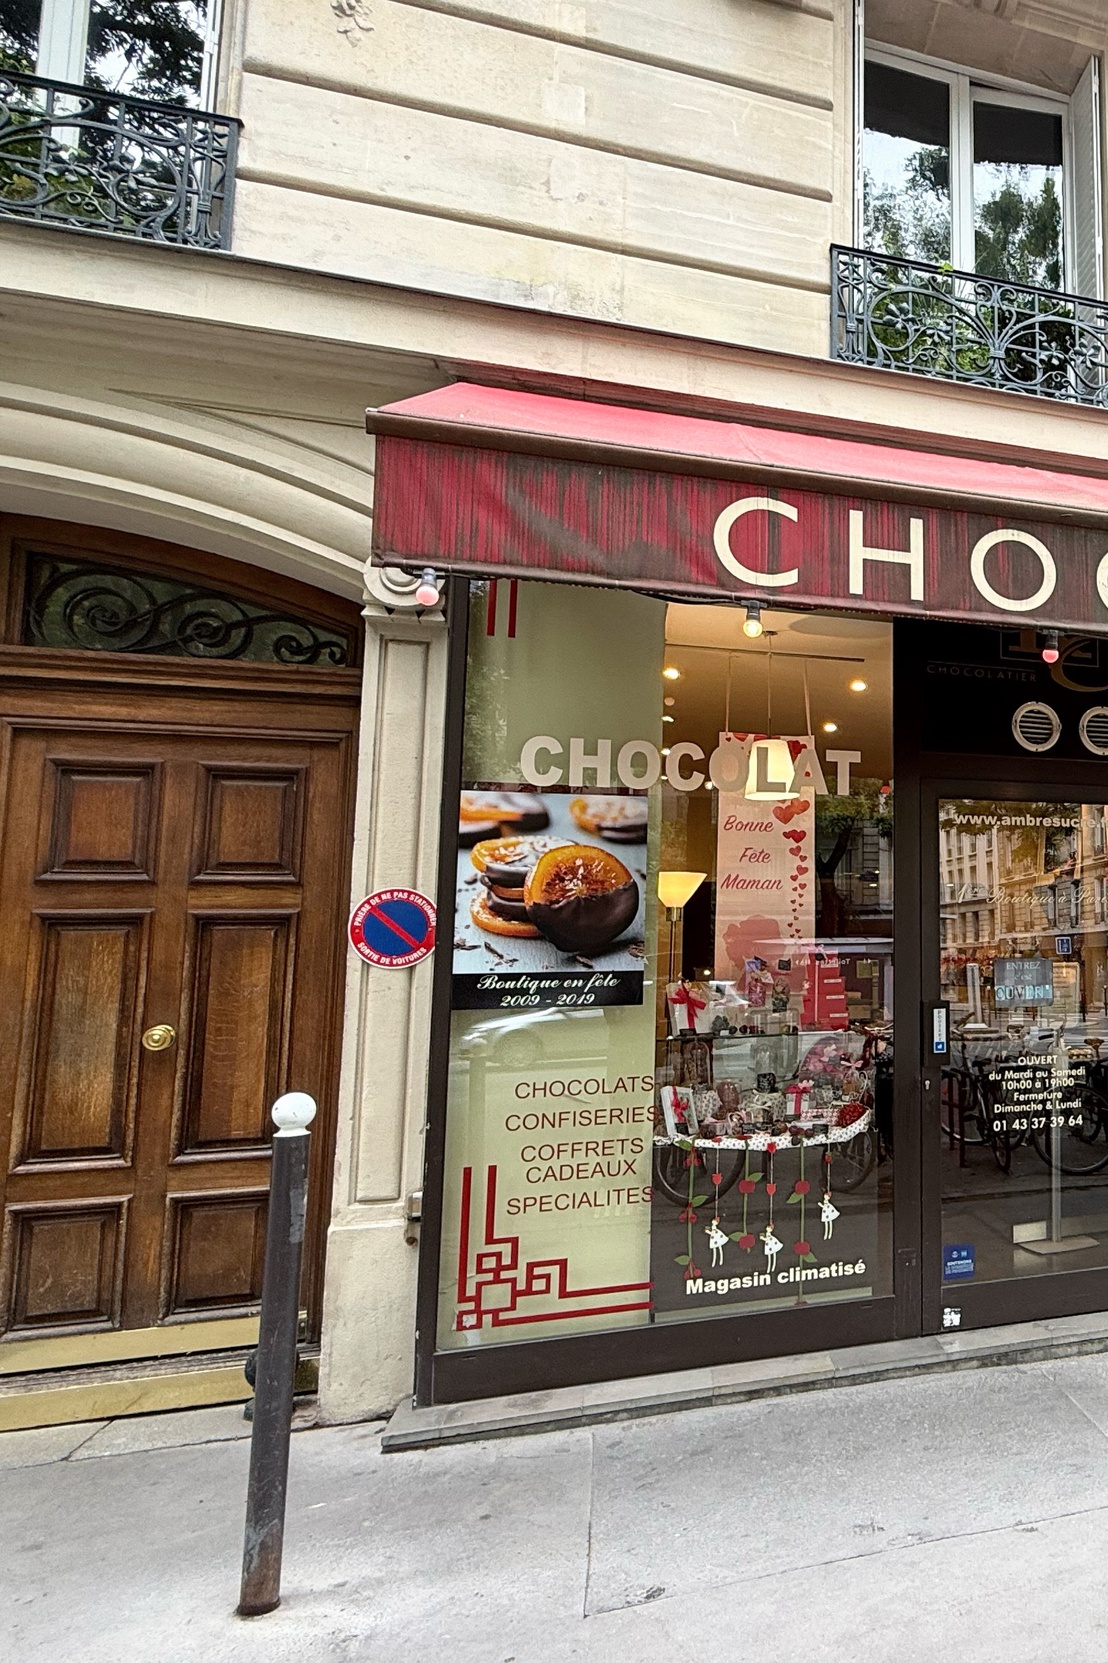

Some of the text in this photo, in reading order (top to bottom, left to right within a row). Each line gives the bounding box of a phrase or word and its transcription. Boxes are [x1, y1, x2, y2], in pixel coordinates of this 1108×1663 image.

[926, 663, 1038, 683] CHOCOLATIER
[520, 735, 862, 796] CHOCOLAT
[723, 815, 775, 832] Bonne
[720, 873, 784, 890] Maman
[370, 897, 382, 906] DE
[381, 891, 392, 900] NE
[393, 891, 408, 899] PAS
[986, 885, 1055, 910] Boutique
[357, 941, 427, 965] SORTIE DE VOITURES
[1006, 961, 1041, 970] ENTREZ
[477, 973, 621, 994] Boutique en fête
[500, 994, 541, 1007] 2009
[556, 993, 596, 1005] 2019
[1017, 1055, 1058, 1066] OUVERT
[988, 1066, 1086, 1081] du Mardi au Samedi
[514, 1075, 655, 1099] CHOCOLATS
[1001, 1077, 1075, 1090] 10h00 à 19h00
[1013, 1091, 1063, 1101] Fermeture
[994, 1098, 1082, 1113] Dimanche & Lundi
[505, 1105, 659, 1132] CONFISERIES
[993, 1114, 1083, 1131] 01 43 37 39 64
[520, 1137, 645, 1163] COFFRETS
[526, 1158, 637, 1184] CADEAUX
[506, 1185, 655, 1216] SPECIALITES
[686, 1259, 866, 1295] Magasin climatisé
